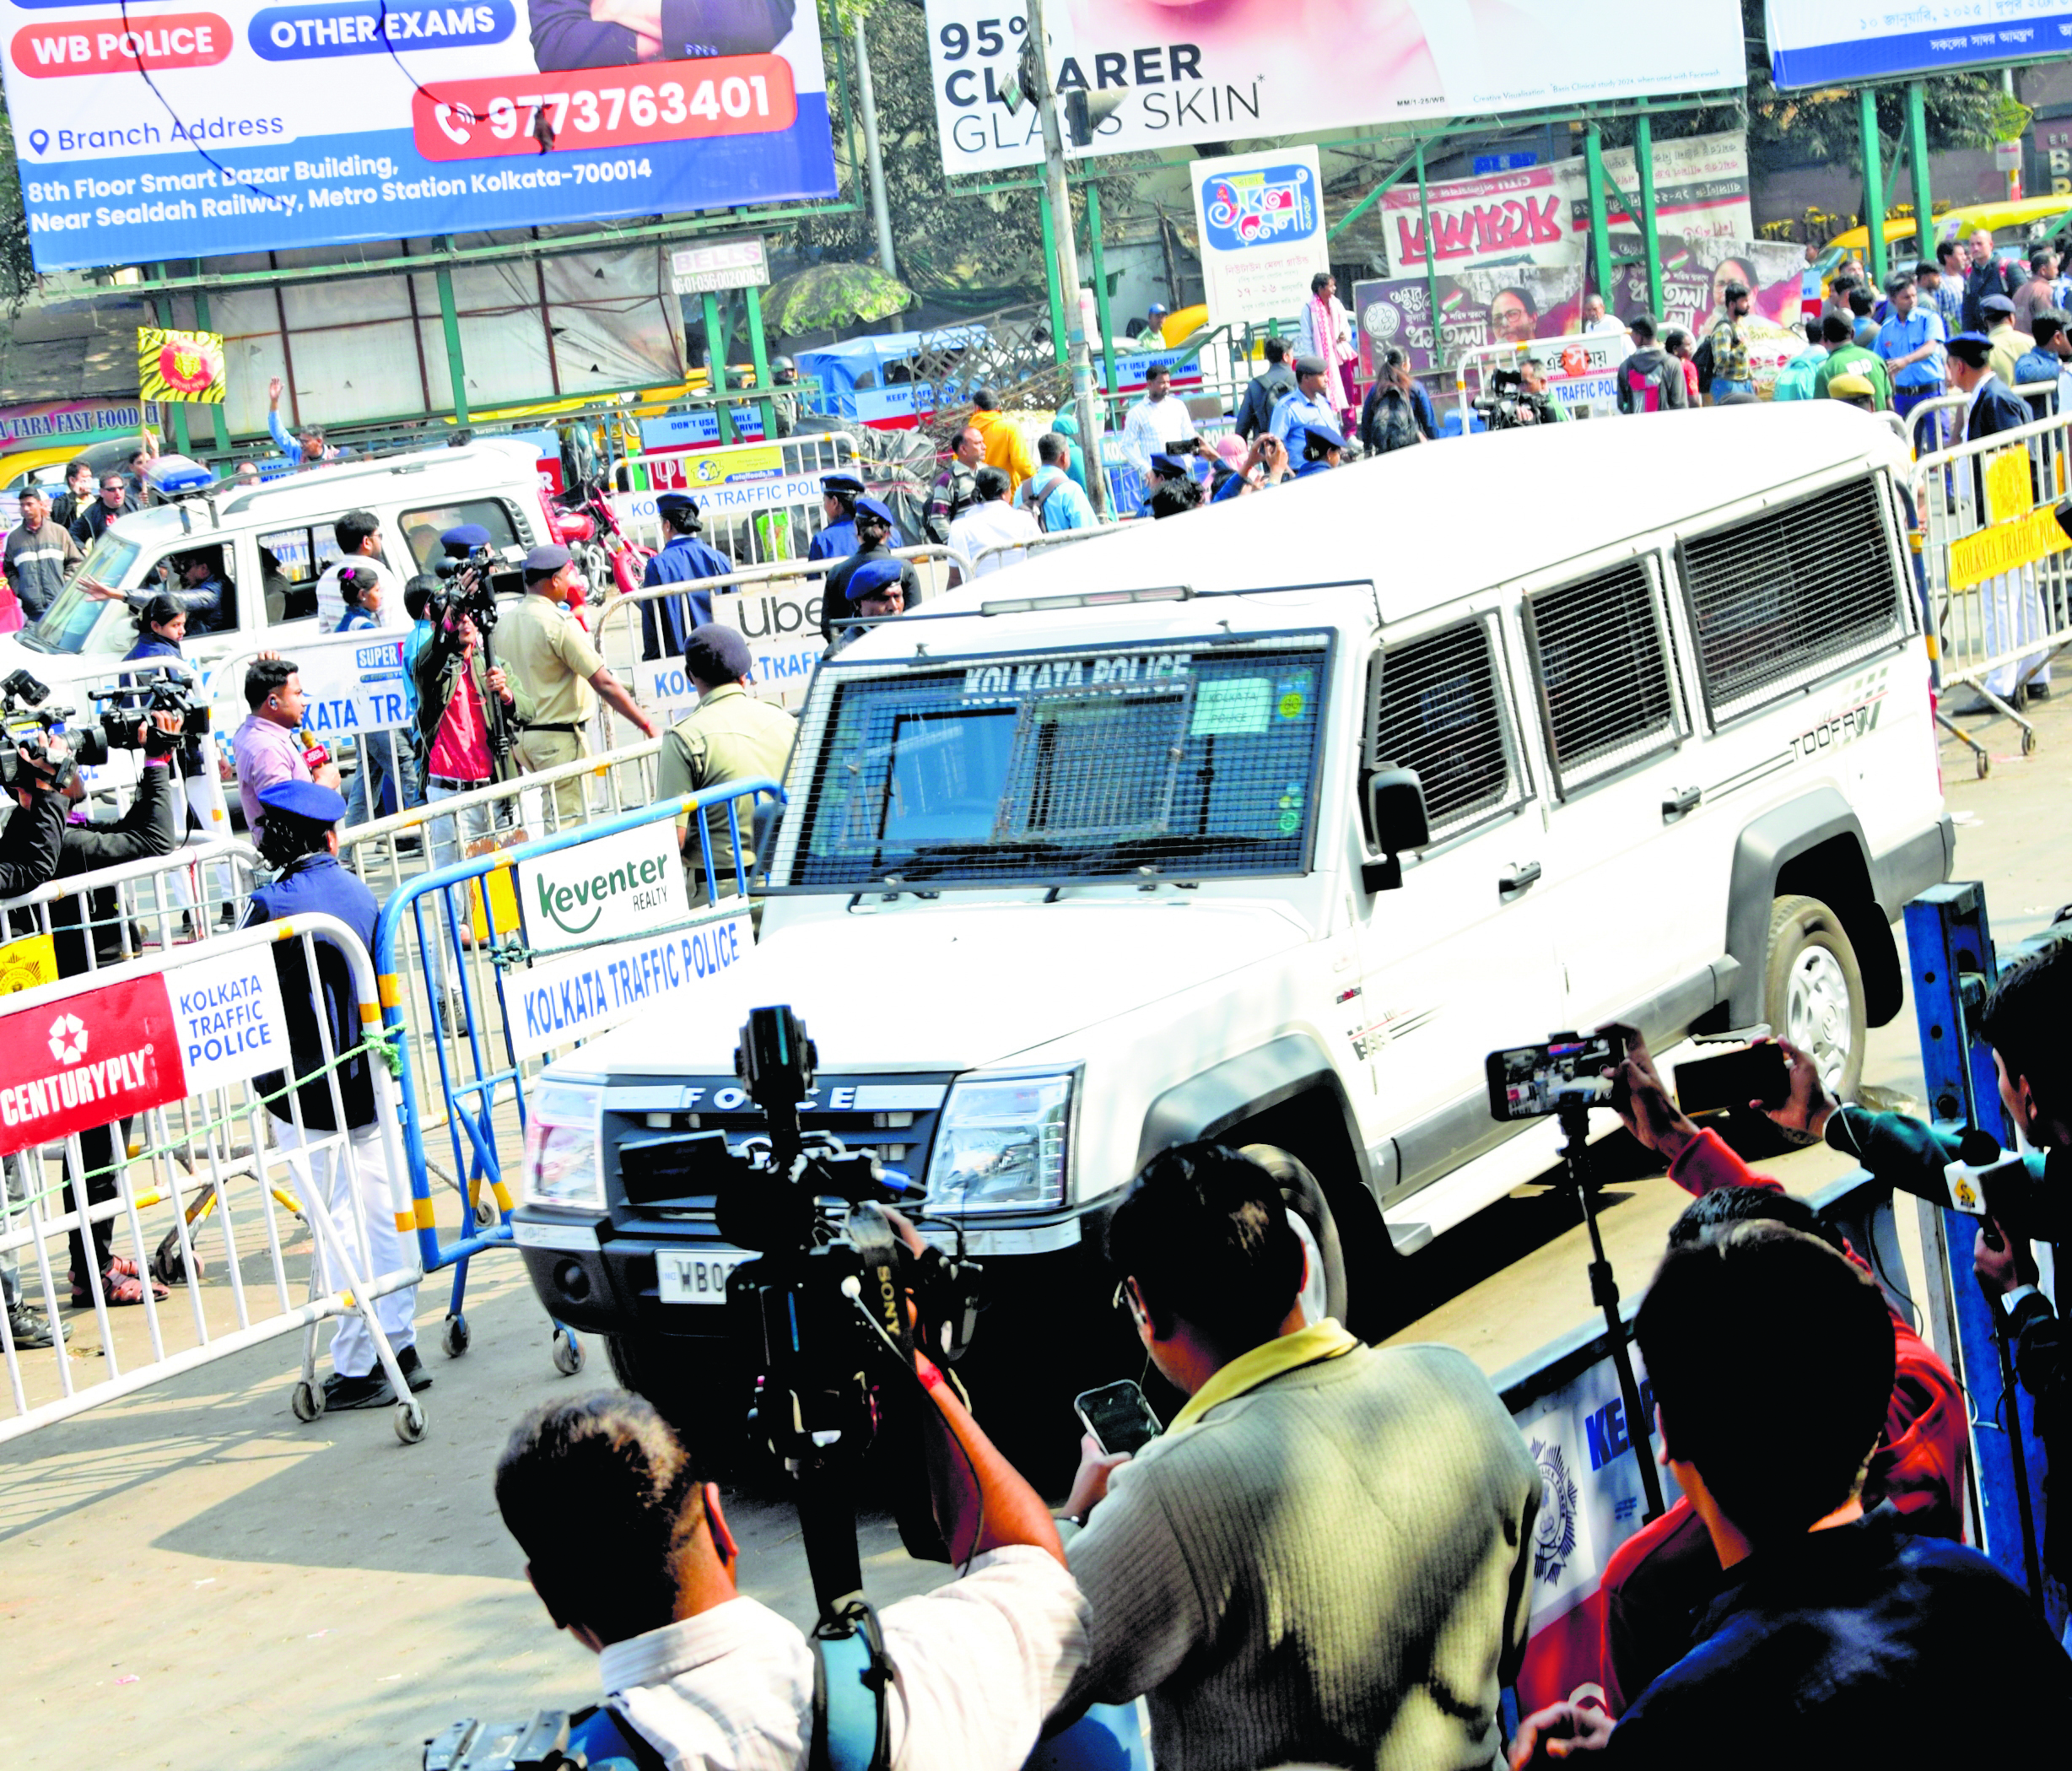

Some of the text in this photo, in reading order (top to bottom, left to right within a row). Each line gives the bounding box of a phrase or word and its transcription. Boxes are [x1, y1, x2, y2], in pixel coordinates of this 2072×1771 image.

[270, 6, 496, 49] OTHER EXAMS
[1859, 17, 1878, 29] ১০
[1943, 4, 1983, 18] ২০২৫
[31, 26, 215, 65] WB POLICE
[1930, 36, 1967, 51] সকলের
[1971, 32, 1995, 46] সাদর
[944, 44, 1203, 107] CLARER
[1571, 80, 1597, 91] Clinical
[1597, 79, 1616, 89] study
[1637, 76, 1655, 84] when
[1655, 73, 1672, 82] used
[1672, 71, 1688, 80] with
[1689, 68, 1721, 78] Facewash
[488, 75, 771, 140] 9773763401
[1473, 88, 1546, 104] Creative Visualisation
[59, 116, 284, 152] Branch Address
[28, 155, 399, 203] 8th Floor Smart Bazar Building,
[30, 159, 652, 233] Near Sealdah Railway, Metro Station Kolkata-700014
[675, 244, 761, 271] BELLS
[1225, 262, 1261, 276] নিউটাউন
[1264, 260, 1284, 271] মেলা
[1130, 361, 1147, 370] USE
[887, 392, 908, 402] KEEP
[1556, 379, 1619, 402] TRAFFIC POL
[11, 414, 54, 438] TARA
[56, 411, 92, 433] FAST
[95, 407, 141, 429] FOOD
[671, 419, 697, 430] DON'T
[699, 418, 715, 428] USE
[731, 469, 775, 481] totalfoods.in
[631, 481, 825, 517] KOTA TRAFFIC POLI
[1956, 516, 2064, 580] KOLKATA TRAFFIC POLIC
[737, 596, 823, 639] Ube
[359, 645, 398, 667] SUPER
[758, 651, 823, 681] TRAFF
[960, 653, 1192, 705] KOLKATA POLICE
[1208, 692, 1258, 704] KOLKATA
[300, 699, 359, 732] KATA
[537, 853, 668, 919] keventer
[633, 885, 667, 912] REALTY
[179, 975, 263, 1016] KOLKATA
[524, 922, 741, 1038] KOLKATA TRAFFIC POLICE
[188, 1000, 264, 1039] TRAFFIC
[187, 1023, 272, 1067] POLICE
[676, 1261, 737, 1293] WB0
[876, 1265, 902, 1336] SONY
